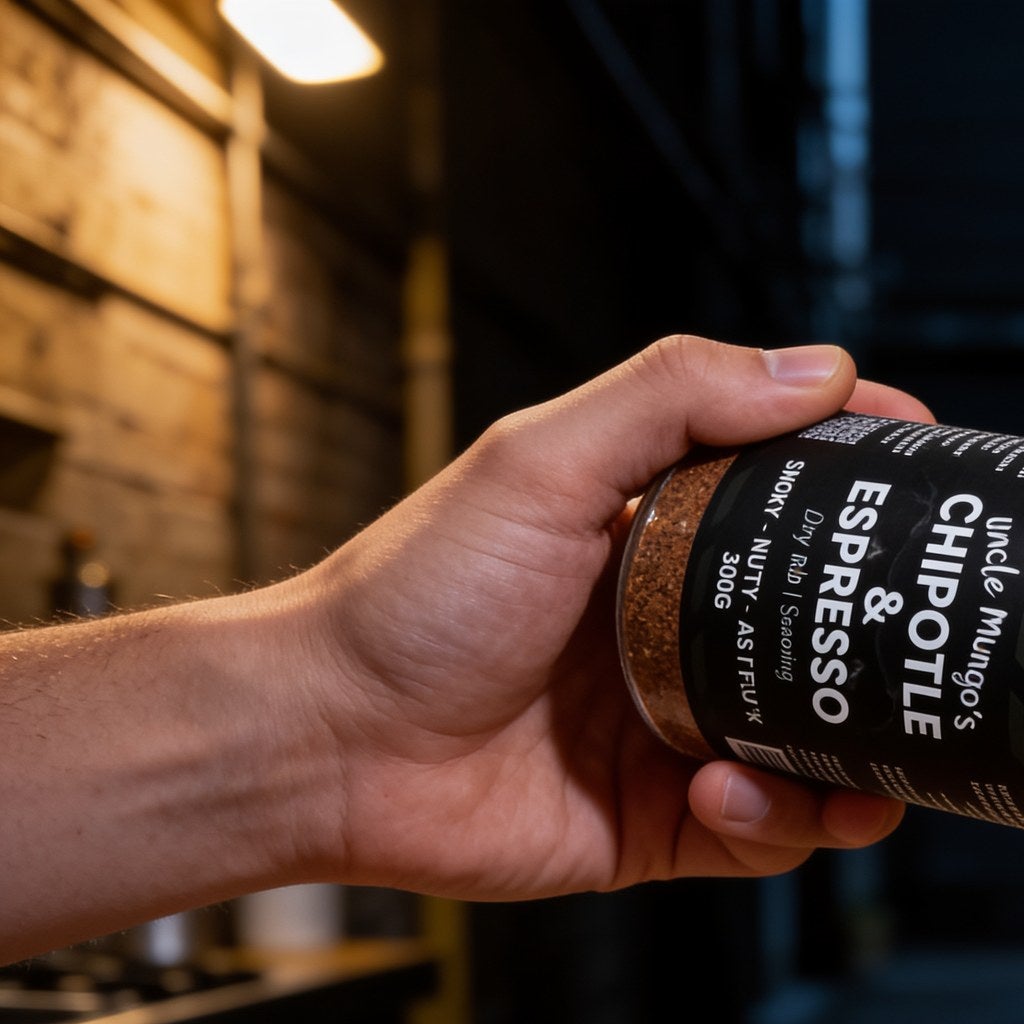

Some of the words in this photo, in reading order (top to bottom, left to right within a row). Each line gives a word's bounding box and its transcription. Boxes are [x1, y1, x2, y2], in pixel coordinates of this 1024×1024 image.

[713, 551, 741, 610] 300G
[741, 537, 772, 601] NUTY
[809, 479, 893, 724] ESPRESSO
[861, 586, 905, 626] &
[902, 493, 984, 740] CHIPOTLE
[951, 606, 1009, 730] Mungo's
